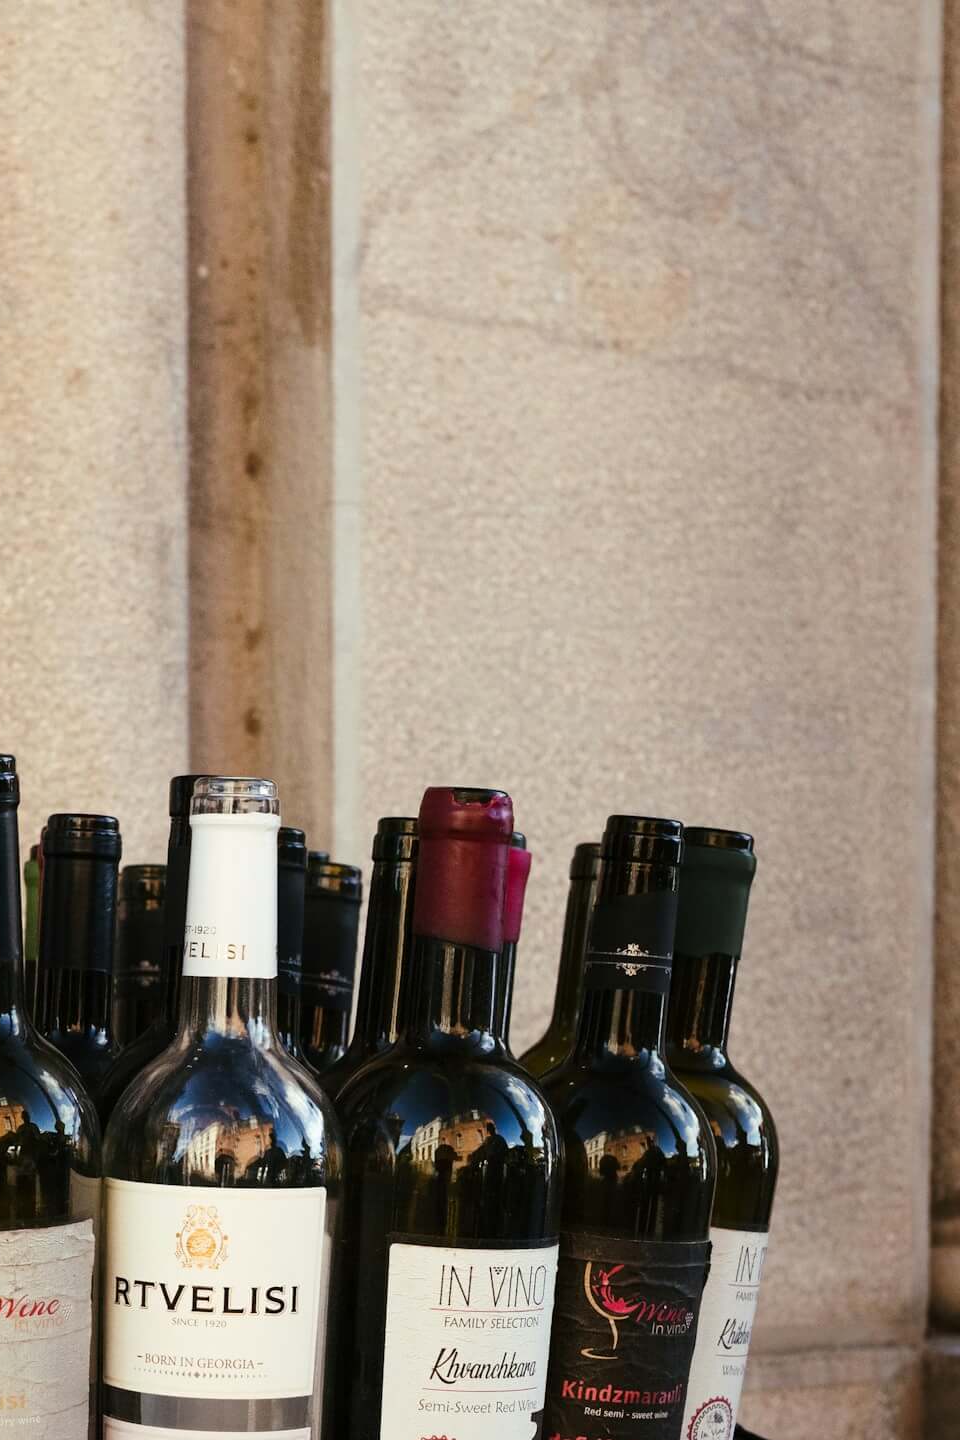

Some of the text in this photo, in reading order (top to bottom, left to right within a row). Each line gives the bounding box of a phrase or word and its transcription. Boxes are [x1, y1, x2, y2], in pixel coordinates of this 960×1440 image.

[438, 1264, 547, 1308] IN VINO
[114, 1276, 299, 1314] RTVELISI
[171, 1317, 228, 1329] SINCE 1920
[443, 1315, 539, 1329] FAMILY SELECTION
[651, 1321, 687, 1335] In vino
[144, 1353, 255, 1370] BORN IN GEORGIA
[428, 1347, 537, 1385] Khvanchkara
[561, 1379, 683, 1406] Kindzmarauli
[416, 1398, 491, 1414] Semi-Sweet
[495, 1401, 516, 1413] Red
[584, 1407, 602, 1417] Red
[603, 1410, 624, 1420] semi
[632, 1412, 653, 1420] sweet
